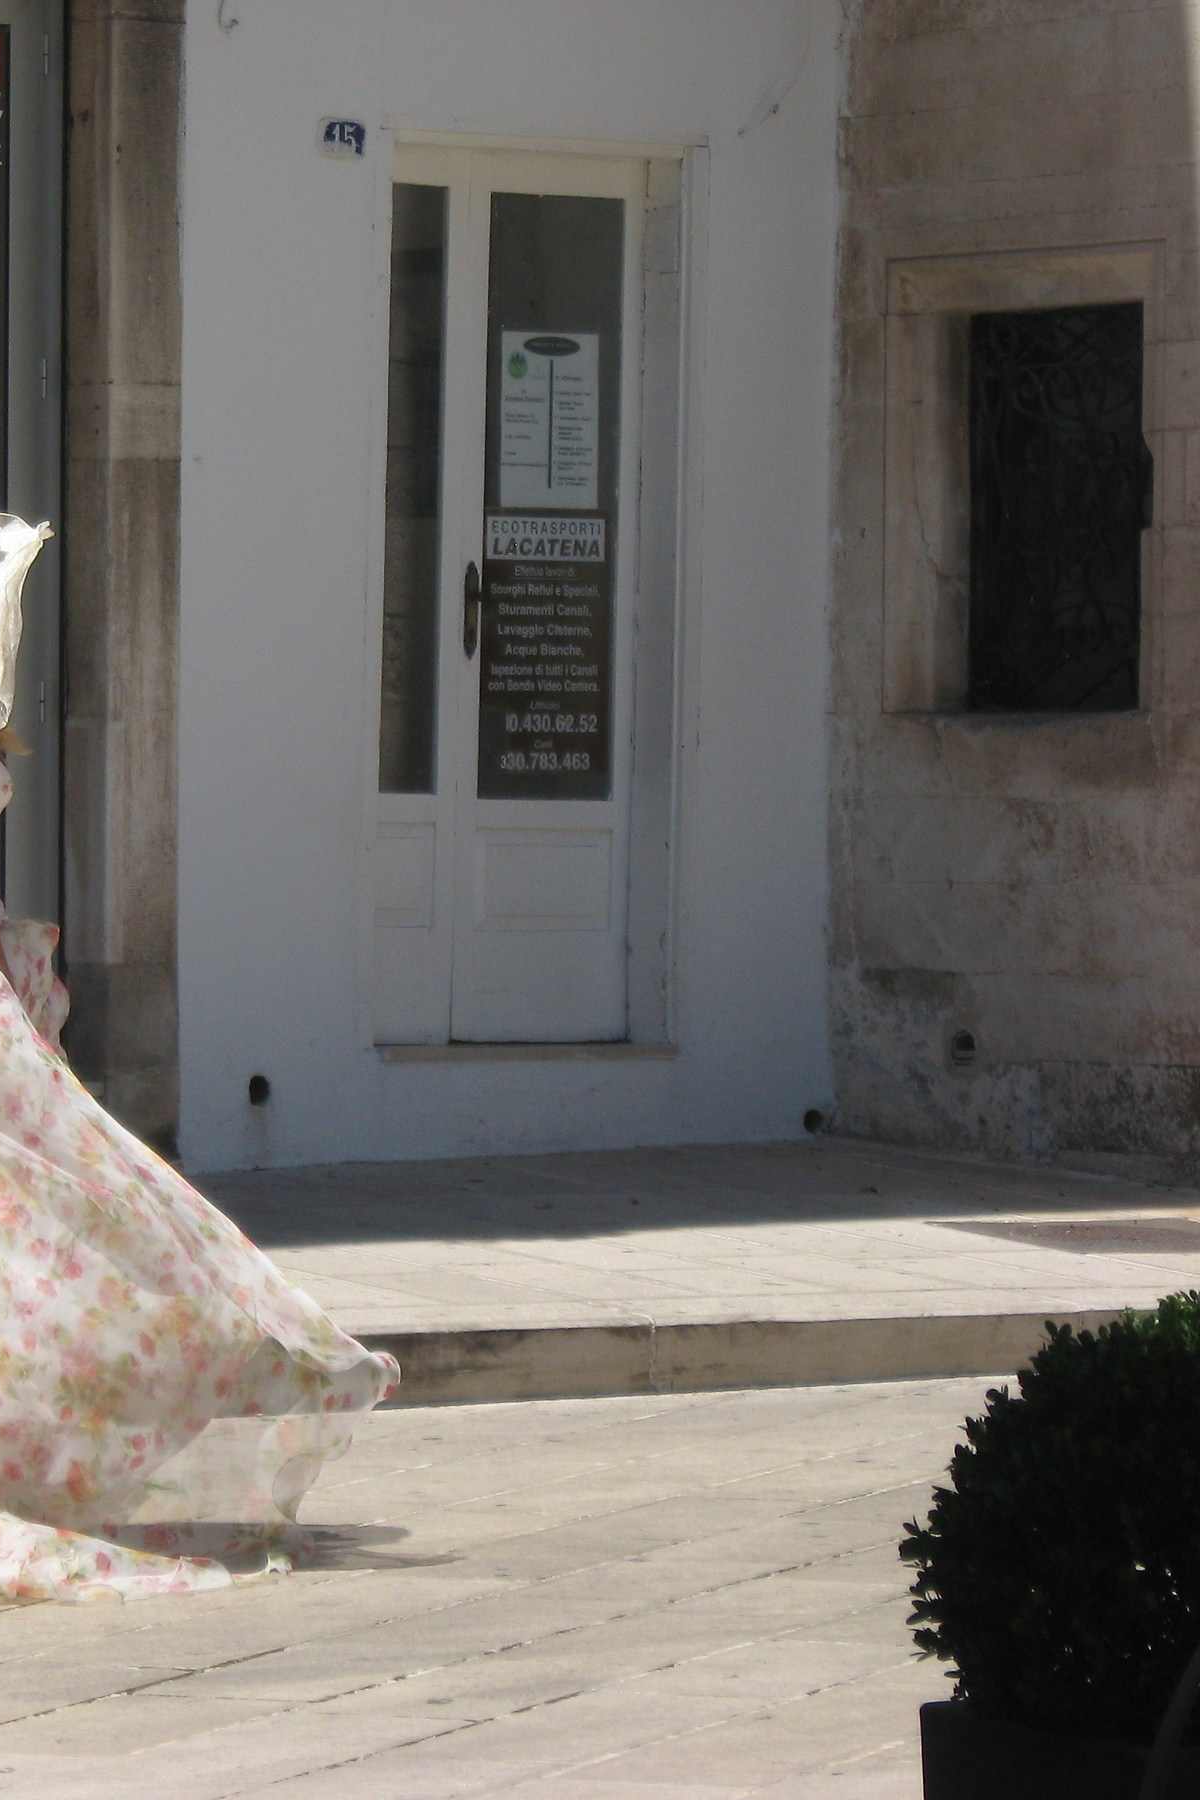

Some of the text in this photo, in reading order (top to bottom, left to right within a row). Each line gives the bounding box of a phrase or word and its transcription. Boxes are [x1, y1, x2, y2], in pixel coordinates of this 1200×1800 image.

[492, 520, 601, 535] ECOTRASPORTI
[493, 538, 600, 557] LACATENA
[498, 603, 554, 615] Sturamenti
[497, 623, 544, 638] Lavaggio
[505, 644, 538, 658] Acque
